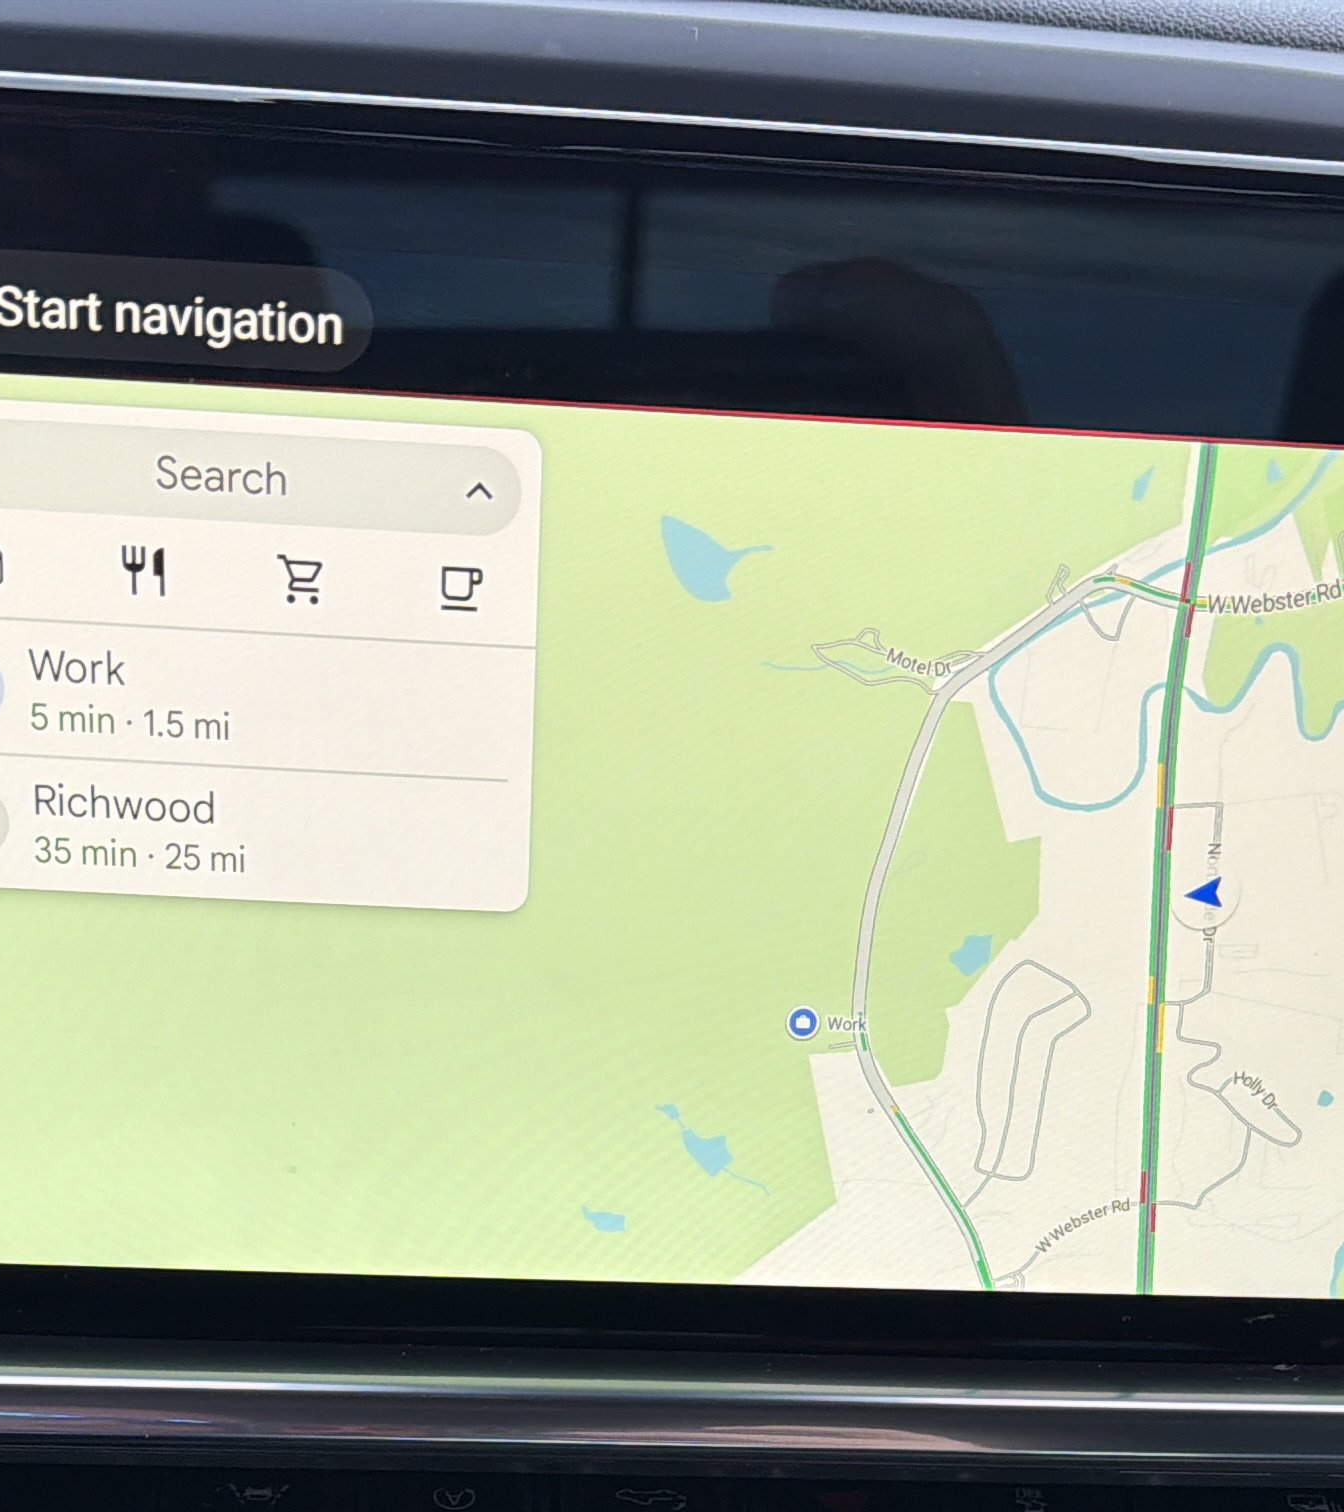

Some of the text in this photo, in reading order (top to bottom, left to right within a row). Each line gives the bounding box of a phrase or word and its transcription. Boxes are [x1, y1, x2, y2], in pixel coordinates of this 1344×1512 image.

[115, 295, 343, 349] navigation
[155, 454, 288, 498] Search
[1208, 578, 1342, 615] W Webster Rd
[28, 648, 126, 686] Work
[886, 647, 952, 677] Motel Dr
[31, 702, 230, 741] 5 min 1.5 mi
[34, 782, 215, 825] Richwood
[34, 835, 246, 874] 35 min 25 mi
[1202, 926, 1217, 944] Dr
[827, 1016, 868, 1032] Work
[1233, 1071, 1279, 1110] Holly Dr
[1035, 1197, 1131, 1253] W Webster Rd
